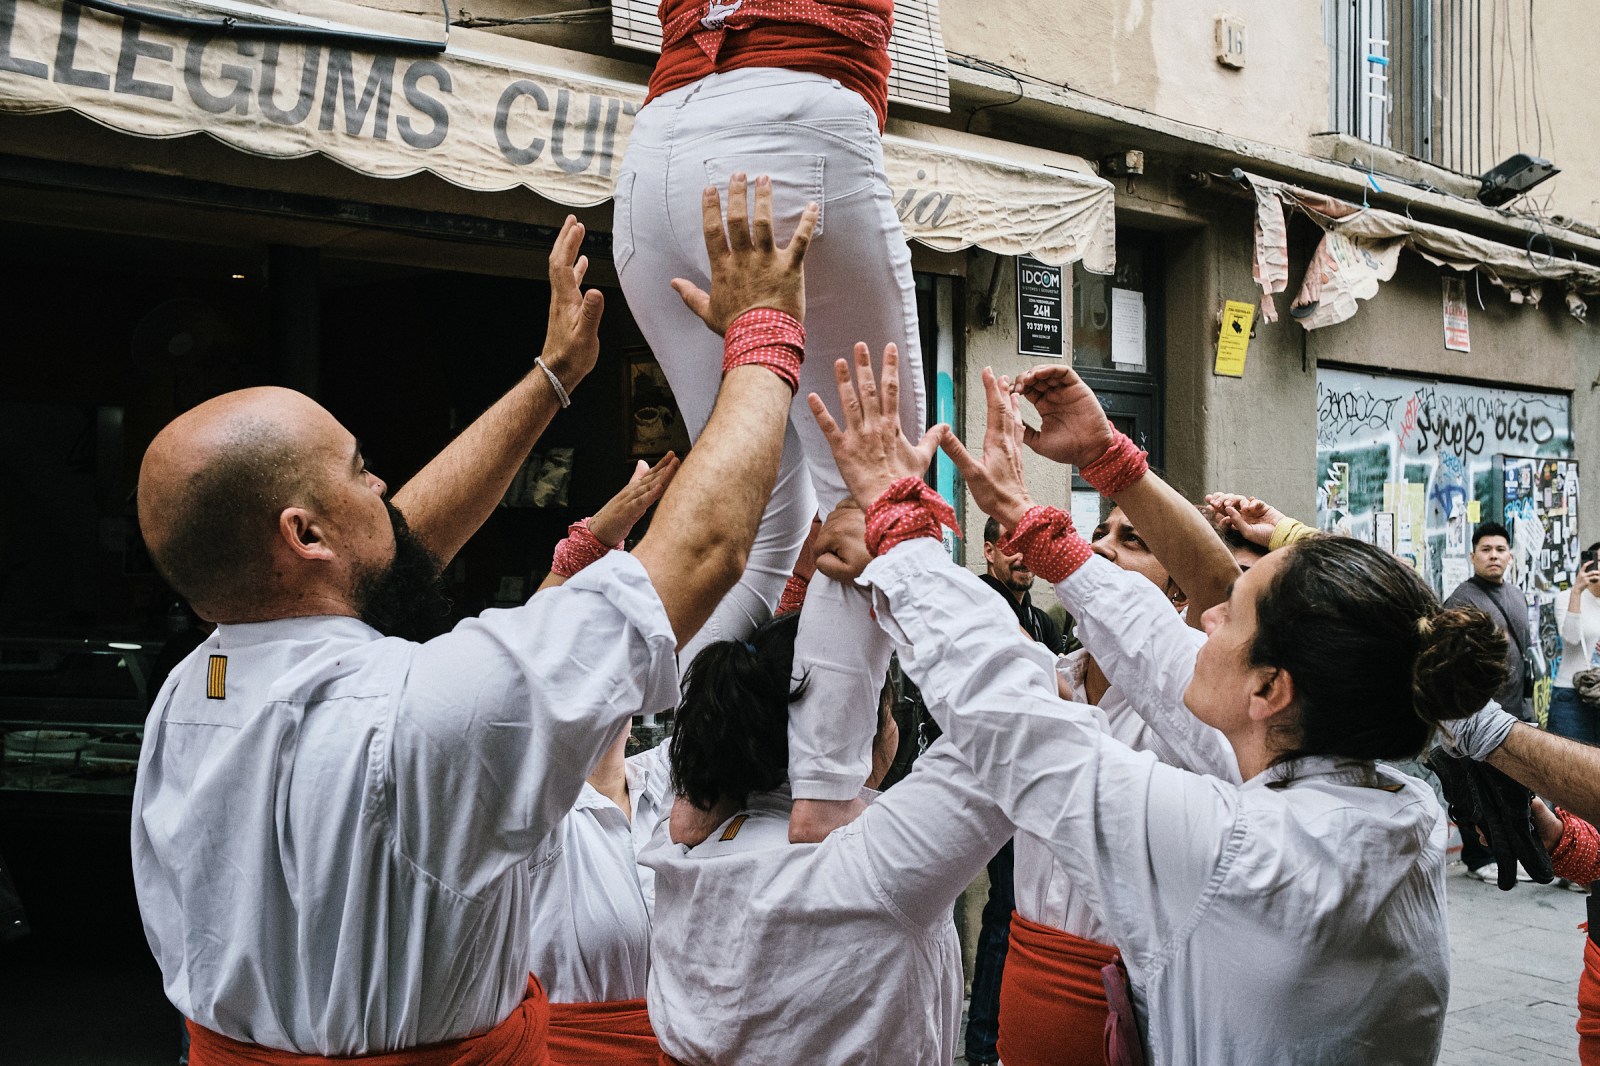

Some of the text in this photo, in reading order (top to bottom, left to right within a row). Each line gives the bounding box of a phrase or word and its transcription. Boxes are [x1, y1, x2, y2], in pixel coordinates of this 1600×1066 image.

[0, 0, 643, 177] LLEGUMS CUI
[885, 168, 954, 228] ia
[1022, 269, 1060, 288] IDCOM
[1033, 304, 1051, 317] 24H
[1026, 322, 1058, 333] 93 737 99 12
